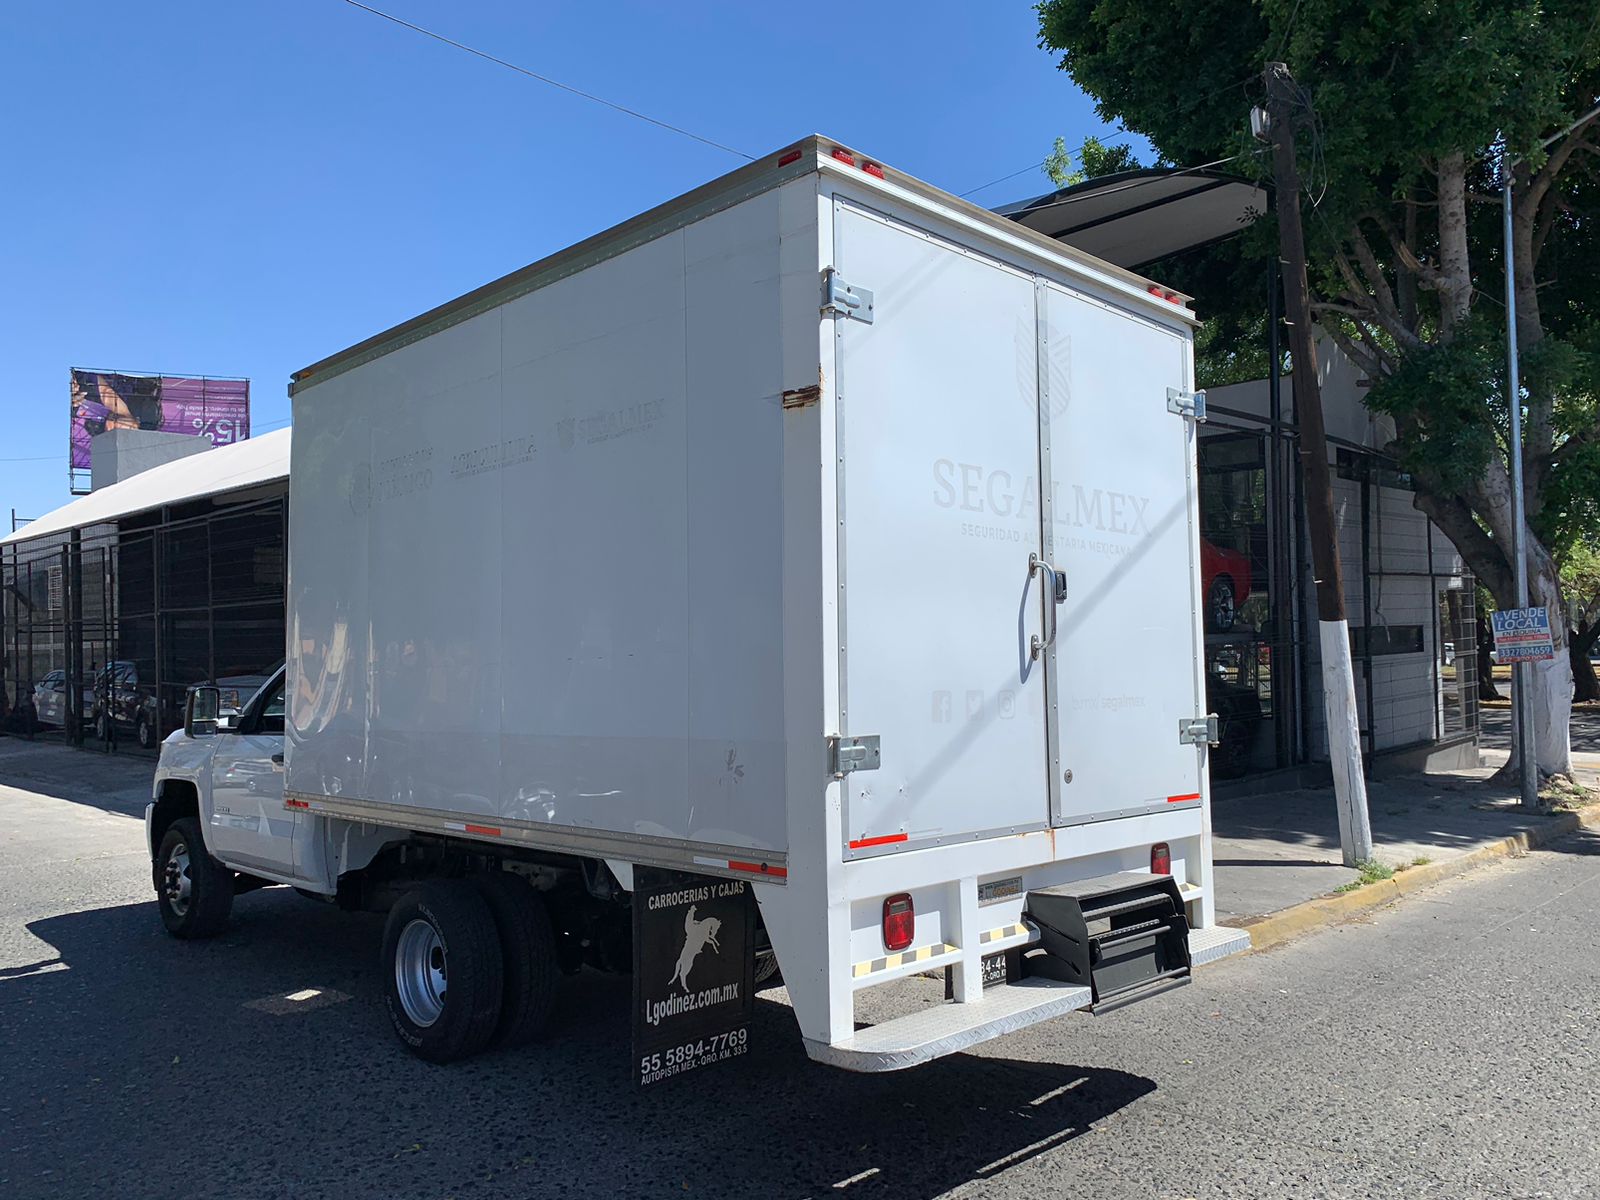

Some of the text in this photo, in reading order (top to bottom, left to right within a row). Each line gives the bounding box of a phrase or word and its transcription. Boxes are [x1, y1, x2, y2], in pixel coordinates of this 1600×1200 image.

[932, 458, 1151, 535] SEGALMEX
[960, 522, 1020, 543] SEGURIDAD
[1023, 531, 1086, 550] ALENTARIA
[1497, 617, 1541, 630] LOCAL
[1503, 607, 1545, 620] VENDE
[648, 881, 745, 910] CARROCERIAS Y CAJAS
[641, 1028, 747, 1074] 55 5894-7769
[641, 1065, 680, 1085] AUTOPISTA
